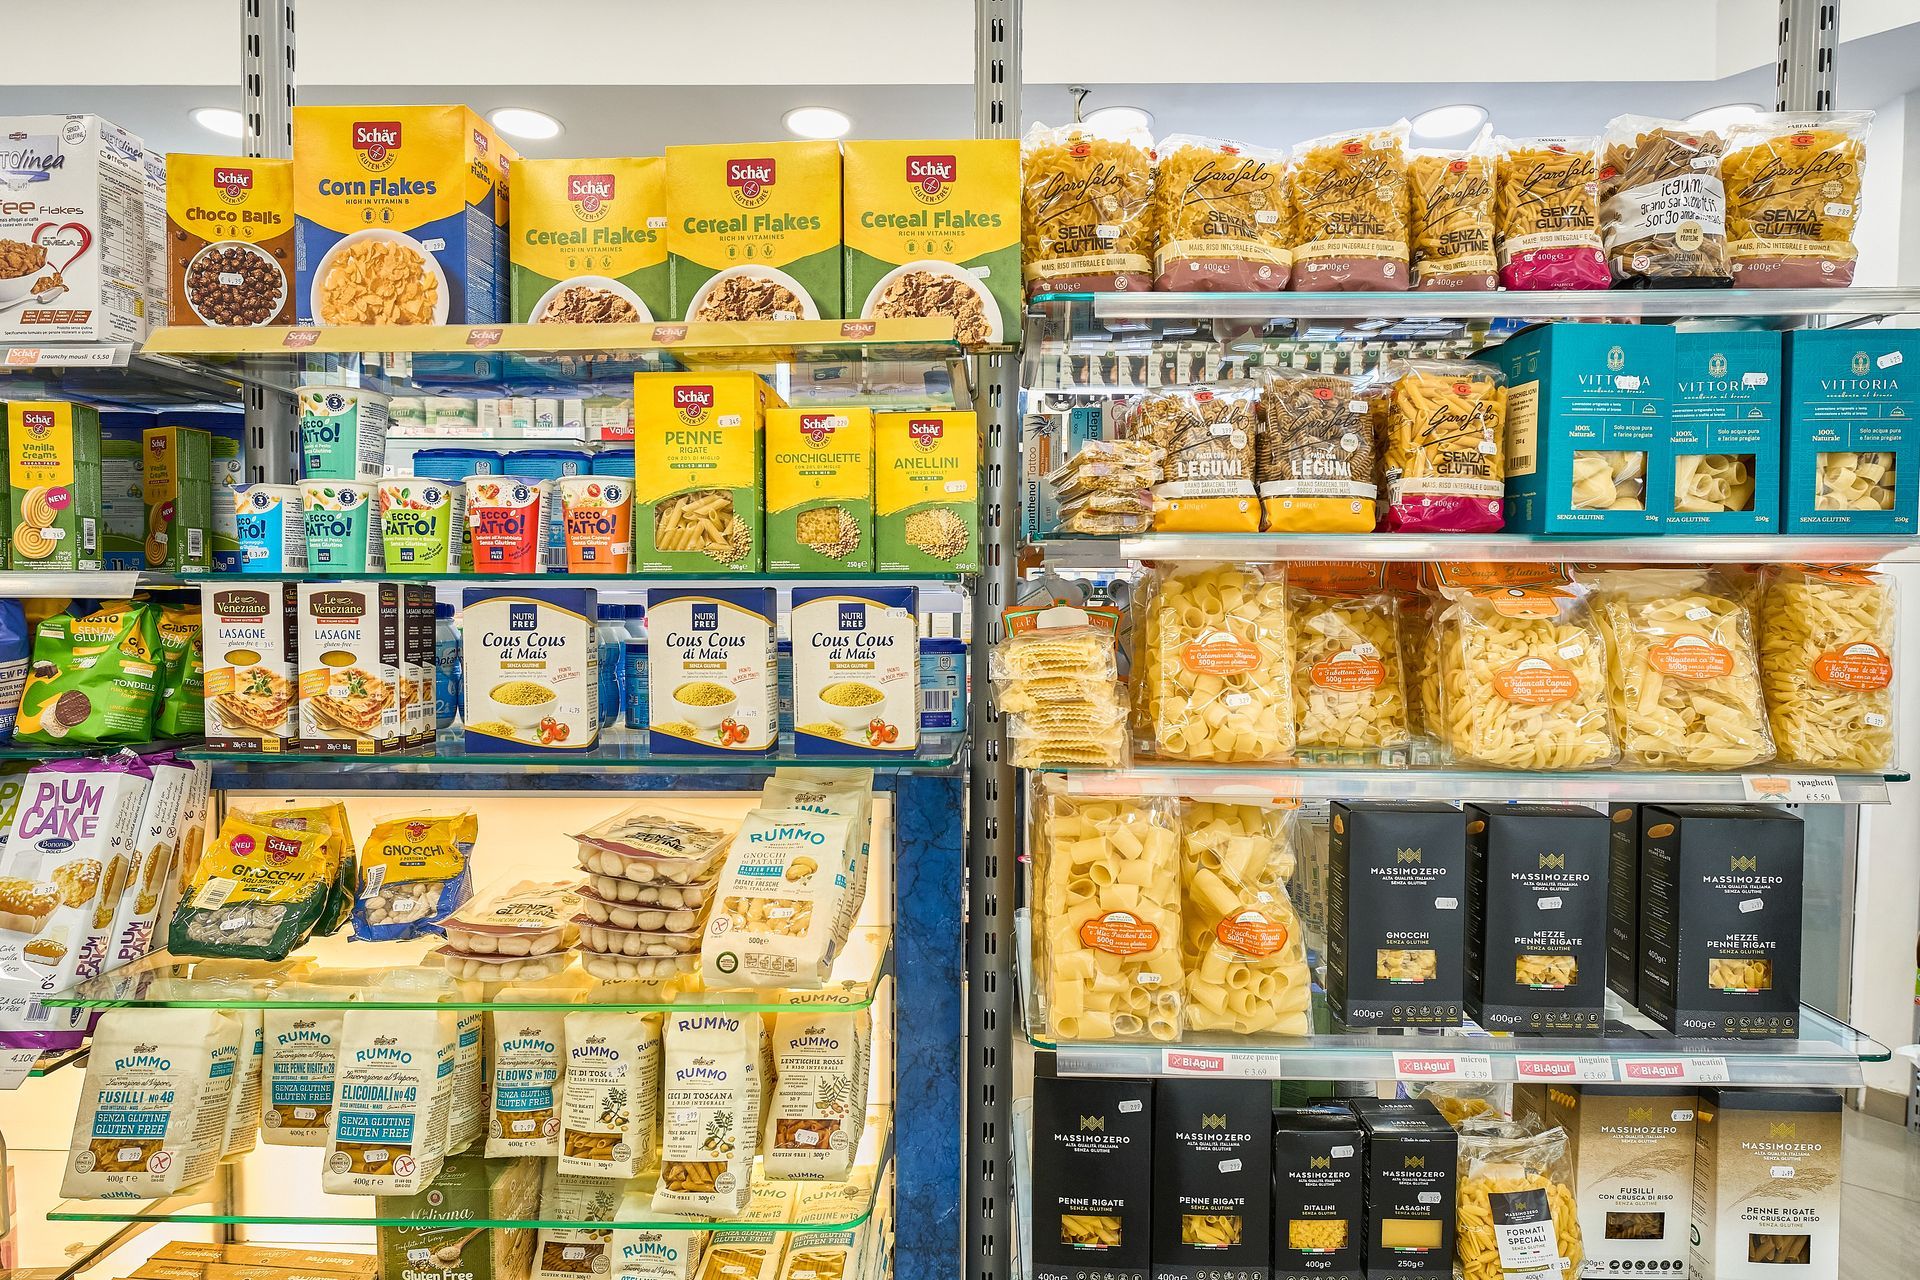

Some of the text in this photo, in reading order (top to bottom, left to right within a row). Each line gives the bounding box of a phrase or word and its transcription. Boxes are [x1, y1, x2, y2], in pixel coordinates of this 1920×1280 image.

[357, 128, 398, 147] Schär
[473, 157, 488, 173] Corn
[216, 172, 249, 187] Schär
[1188, 159, 1275, 193] Garofalo
[318, 178, 436, 196] Corn Flakes
[571, 180, 611, 197] Schär
[1040, 163, 1123, 212] Garofalo
[186, 208, 281, 225] Choco Balls
[861, 210, 1001, 228] Cereal Flakes
[1331, 212, 1377, 223] SENZA
[683, 212, 821, 234] Cereal Flakes
[526, 227, 658, 245] Cereal Flakes
[1054, 238, 1113, 254] GLUTINE
[1057, 262, 1071, 270] RISO
[1072, 260, 1098, 269] INTEGRALE
[287, 332, 317, 342] Schär
[1821, 378, 1898, 390] VITTORIA
[665, 431, 723, 445] PENNE
[1569, 430, 1596, 438] Naturale
[1812, 434, 1841, 442] Naturale
[1670, 436, 1698, 444] Naturale
[23, 443, 54, 452] Vanilla
[679, 446, 708, 454] RIGATE
[22, 451, 57, 460] Creams
[775, 453, 861, 464] CONCHIGLIETTE
[894, 457, 959, 469] ANELLINI
[1178, 463, 1242, 478] LEGUMI
[48, 493, 67, 502] NEW
[308, 511, 337, 522] ECCO
[391, 512, 420, 522] ECCO
[305, 517, 352, 537] FATTO!
[228, 593, 240, 603] Le
[217, 603, 266, 613] Veneziane
[313, 603, 362, 614] Veneziane
[513, 612, 535, 621] NUTRI
[694, 611, 716, 621] NUTRI
[840, 612, 863, 621] NUTRI
[513, 620, 535, 629] FREE
[694, 620, 716, 629] FREE
[841, 620, 864, 629] FREE
[219, 629, 265, 638] LASAGNE
[315, 630, 361, 639] LASAGNE
[482, 632, 567, 649] Cous Cous
[666, 632, 745, 649] Cous Cous
[500, 647, 550, 660] di Mais
[1198, 659, 1216, 667] 500g
[113, 679, 156, 691] TONDELLE
[1797, 780, 1834, 789] spaghetti
[34, 780, 105, 817] PLUM
[19, 806, 100, 841] CAKE
[750, 828, 825, 845] RUMMO
[234, 842, 251, 851] NEU
[382, 844, 445, 857] GNOCCHI
[231, 864, 305, 882] GNOCCHI
[278, 1030, 331, 1046] RUMMO
[115, 1056, 170, 1071] RUMMO
[1578, 1057, 1609, 1065] linguine
[496, 1070, 557, 1080] ELBOWS 160
[98, 1091, 174, 1102] FUSILLI 48
[342, 1085, 416, 1101] ELICOIDALI 49
[98, 1114, 167, 1122] SENZA GLUTINE
[342, 1116, 410, 1126] SENZA GLUTINE
[96, 1125, 164, 1134] GLUTEN FREE
[341, 1127, 409, 1138] GLUTEN FREE
[107, 1175, 123, 1183] 400g
[1058, 1197, 1124, 1207] PENNE RIGATE
[1180, 1196, 1244, 1205] PENNE RIGATE
[1506, 1227, 1544, 1237] FORMATI
[1508, 1236, 1547, 1246] SPECIALI
